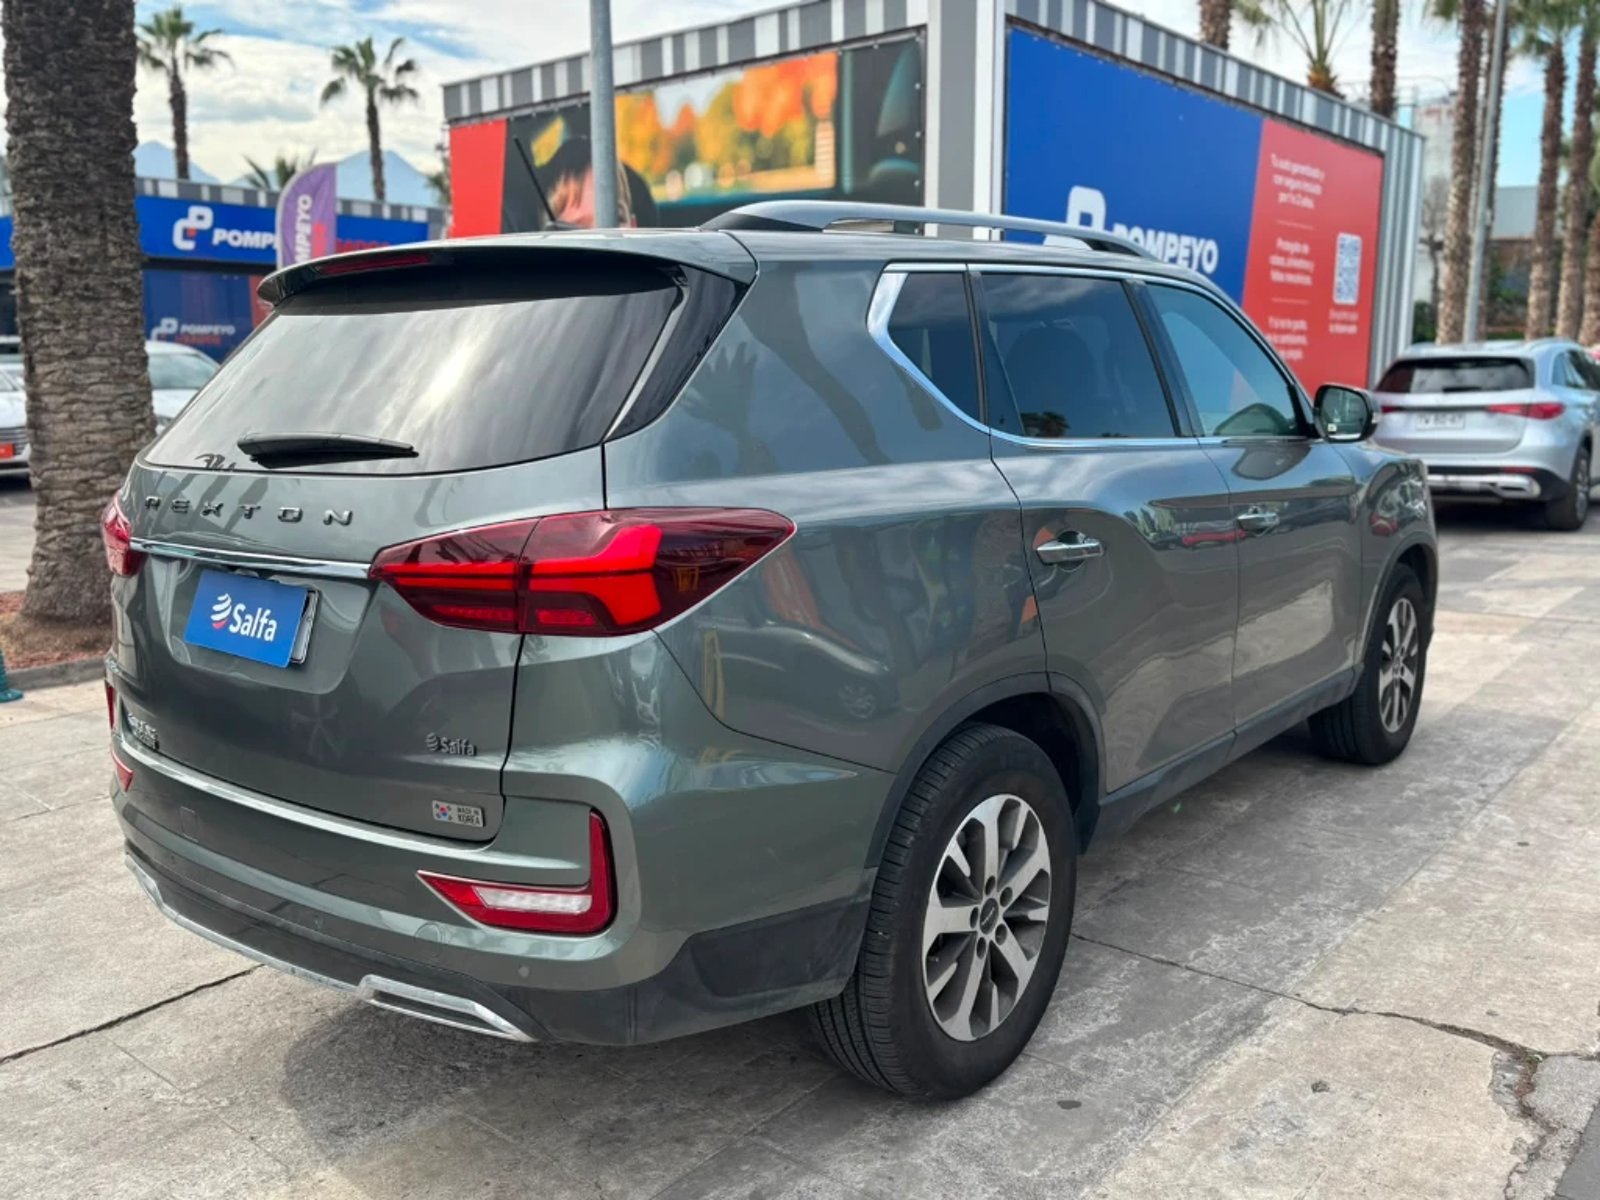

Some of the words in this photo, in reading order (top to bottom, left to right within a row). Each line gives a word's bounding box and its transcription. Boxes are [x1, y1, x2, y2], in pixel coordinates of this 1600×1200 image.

[212, 228, 279, 250] POMP
[295, 194, 313, 264] MPEYO
[145, 496, 353, 526] REXTON
[228, 603, 278, 642] Salfa
[440, 736, 476, 756] Salfa
